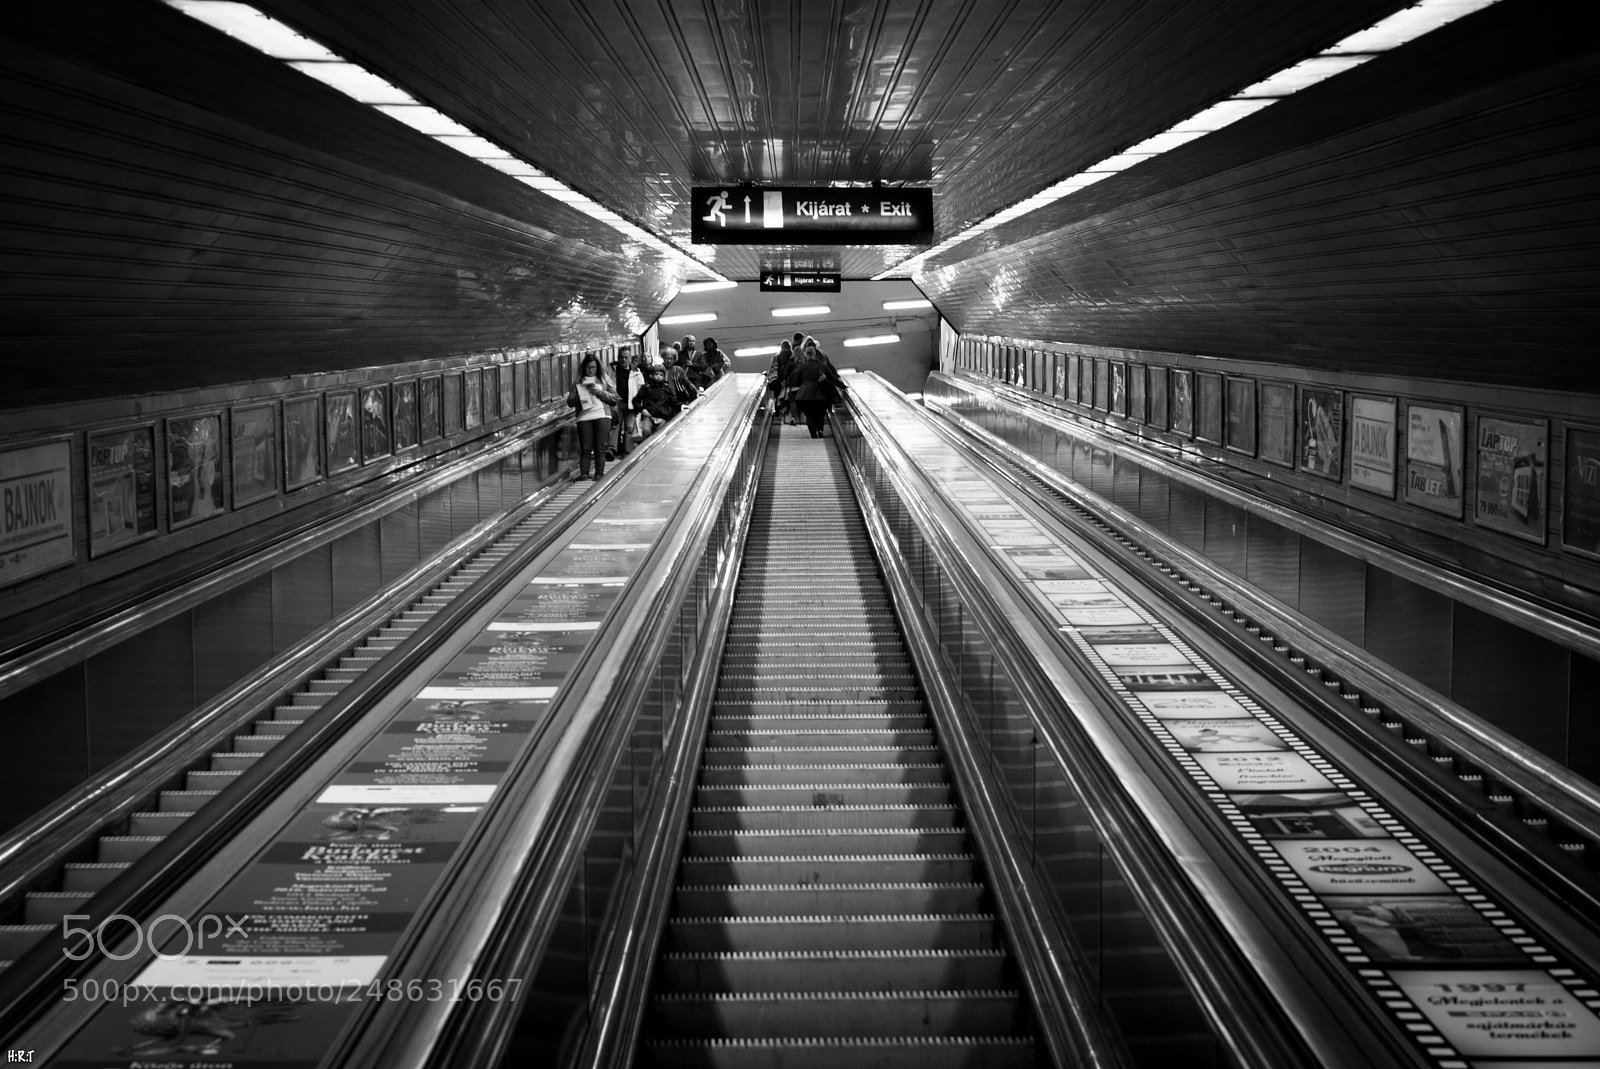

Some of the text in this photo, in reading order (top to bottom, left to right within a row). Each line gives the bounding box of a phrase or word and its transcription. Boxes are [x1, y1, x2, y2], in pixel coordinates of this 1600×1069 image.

[796, 200, 912, 220] Kijárat Exit
[794, 277, 814, 285] Kijárat
[1354, 422, 1360, 452] A
[1361, 423, 1388, 459] BAJNOK
[1481, 427, 1518, 453] LAPTOP
[91, 444, 129, 467] LAPTOP
[1411, 470, 1442, 497] TABLET
[4, 478, 57, 533] BAJNOK
[1302, 846, 1382, 854] 2004
[1433, 983, 1529, 993] 1997
